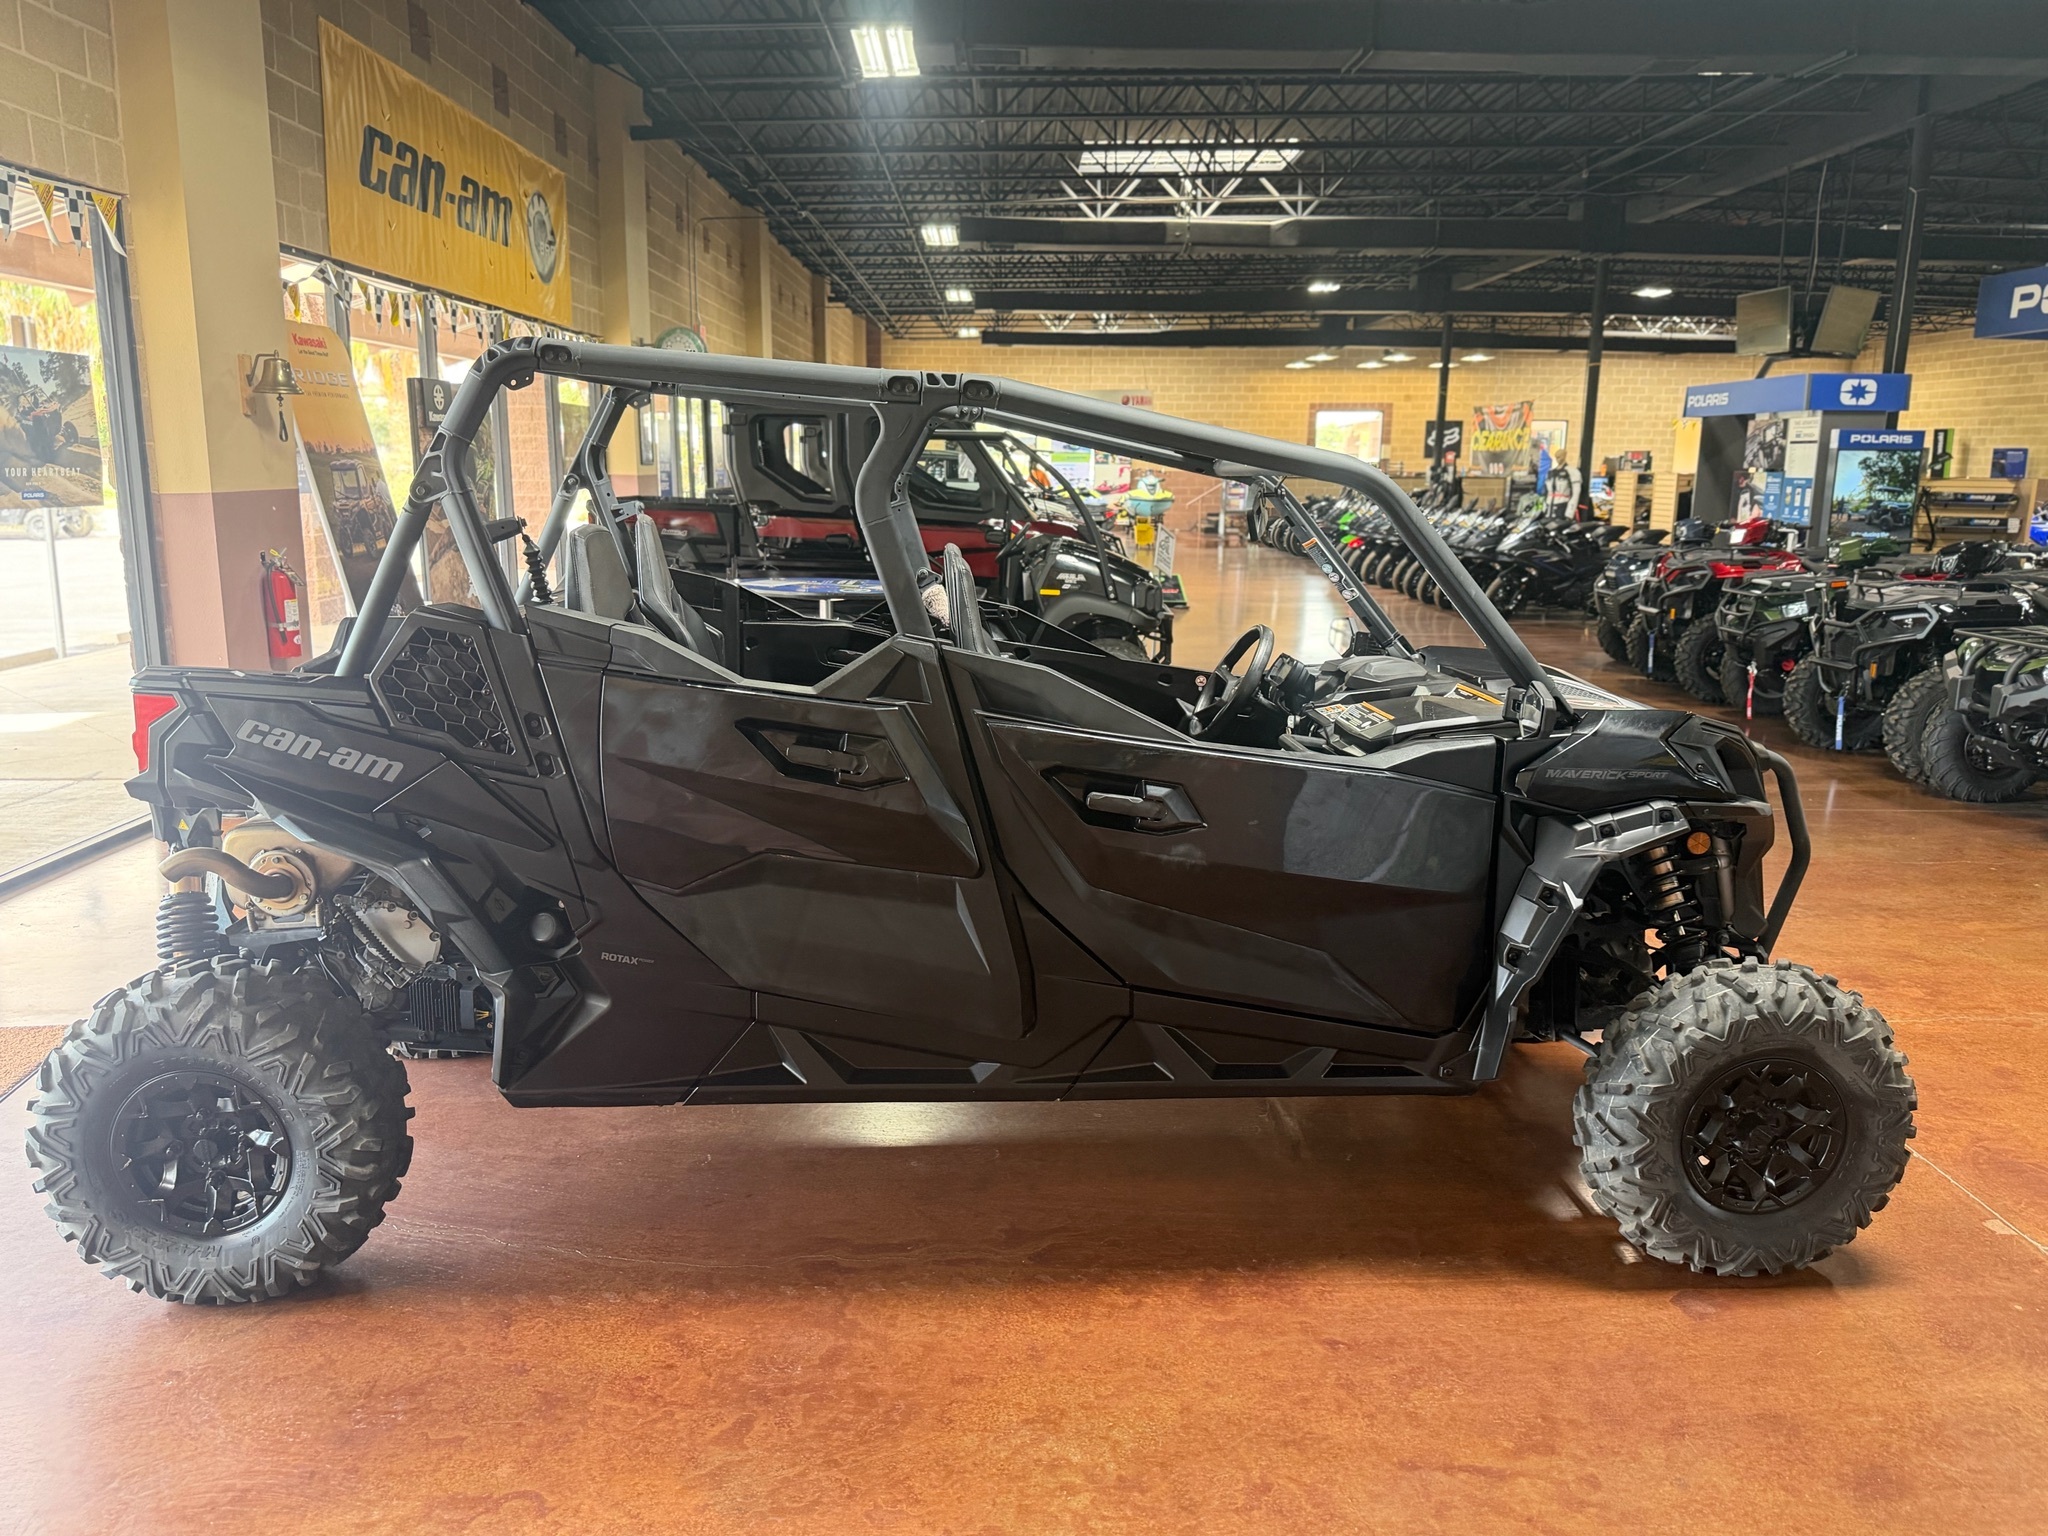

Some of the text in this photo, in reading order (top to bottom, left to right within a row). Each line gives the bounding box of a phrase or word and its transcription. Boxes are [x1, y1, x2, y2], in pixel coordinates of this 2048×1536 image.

[2010, 284, 2048, 319] P
[292, 333, 327, 348] Kawasaki
[1687, 392, 1729, 408] POLARIS
[1850, 434, 1913, 444] POLARIS
[4, 467, 81, 477] YOUR HEARTBEAT
[236, 719, 404, 783] can-am
[1545, 769, 1669, 780] MAVERICK SPORT
[601, 952, 639, 965] ROTAX
